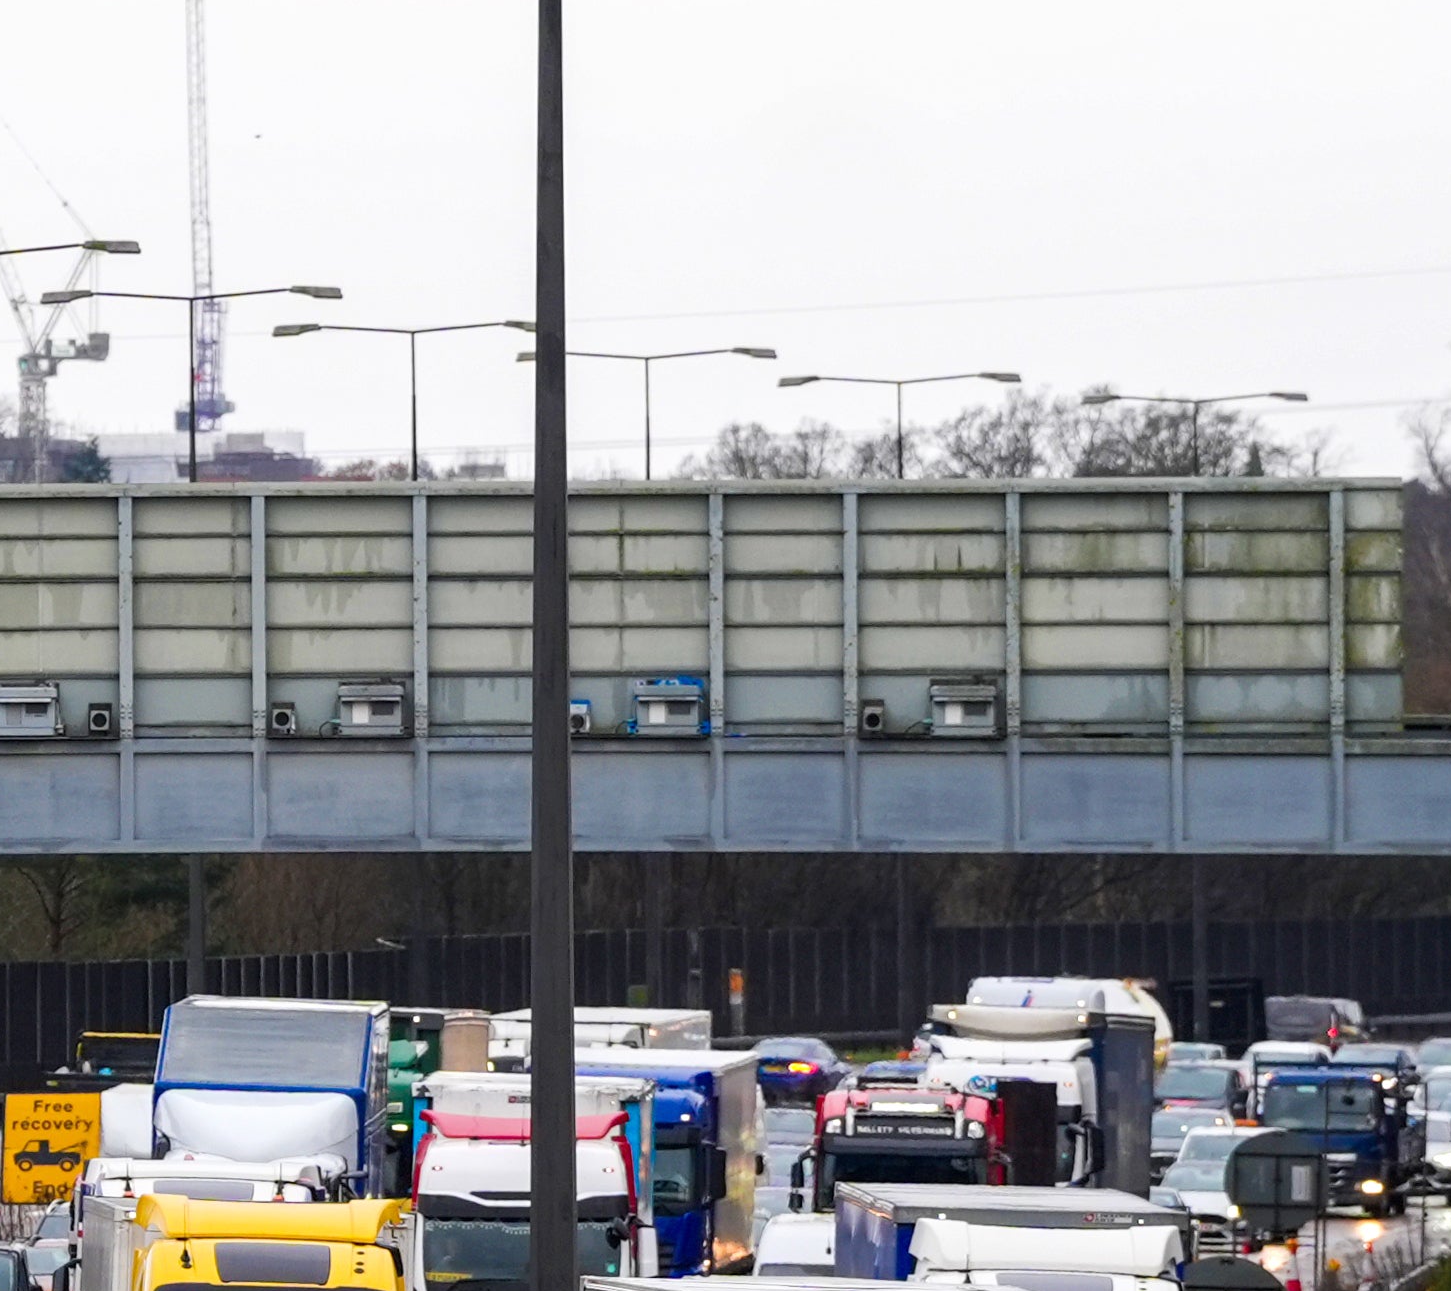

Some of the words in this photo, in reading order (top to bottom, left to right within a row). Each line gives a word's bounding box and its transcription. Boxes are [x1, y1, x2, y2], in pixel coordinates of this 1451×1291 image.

[32, 1099, 74, 1113] Free
[11, 1117, 94, 1132] recovery
[32, 1180, 69, 1195] End
